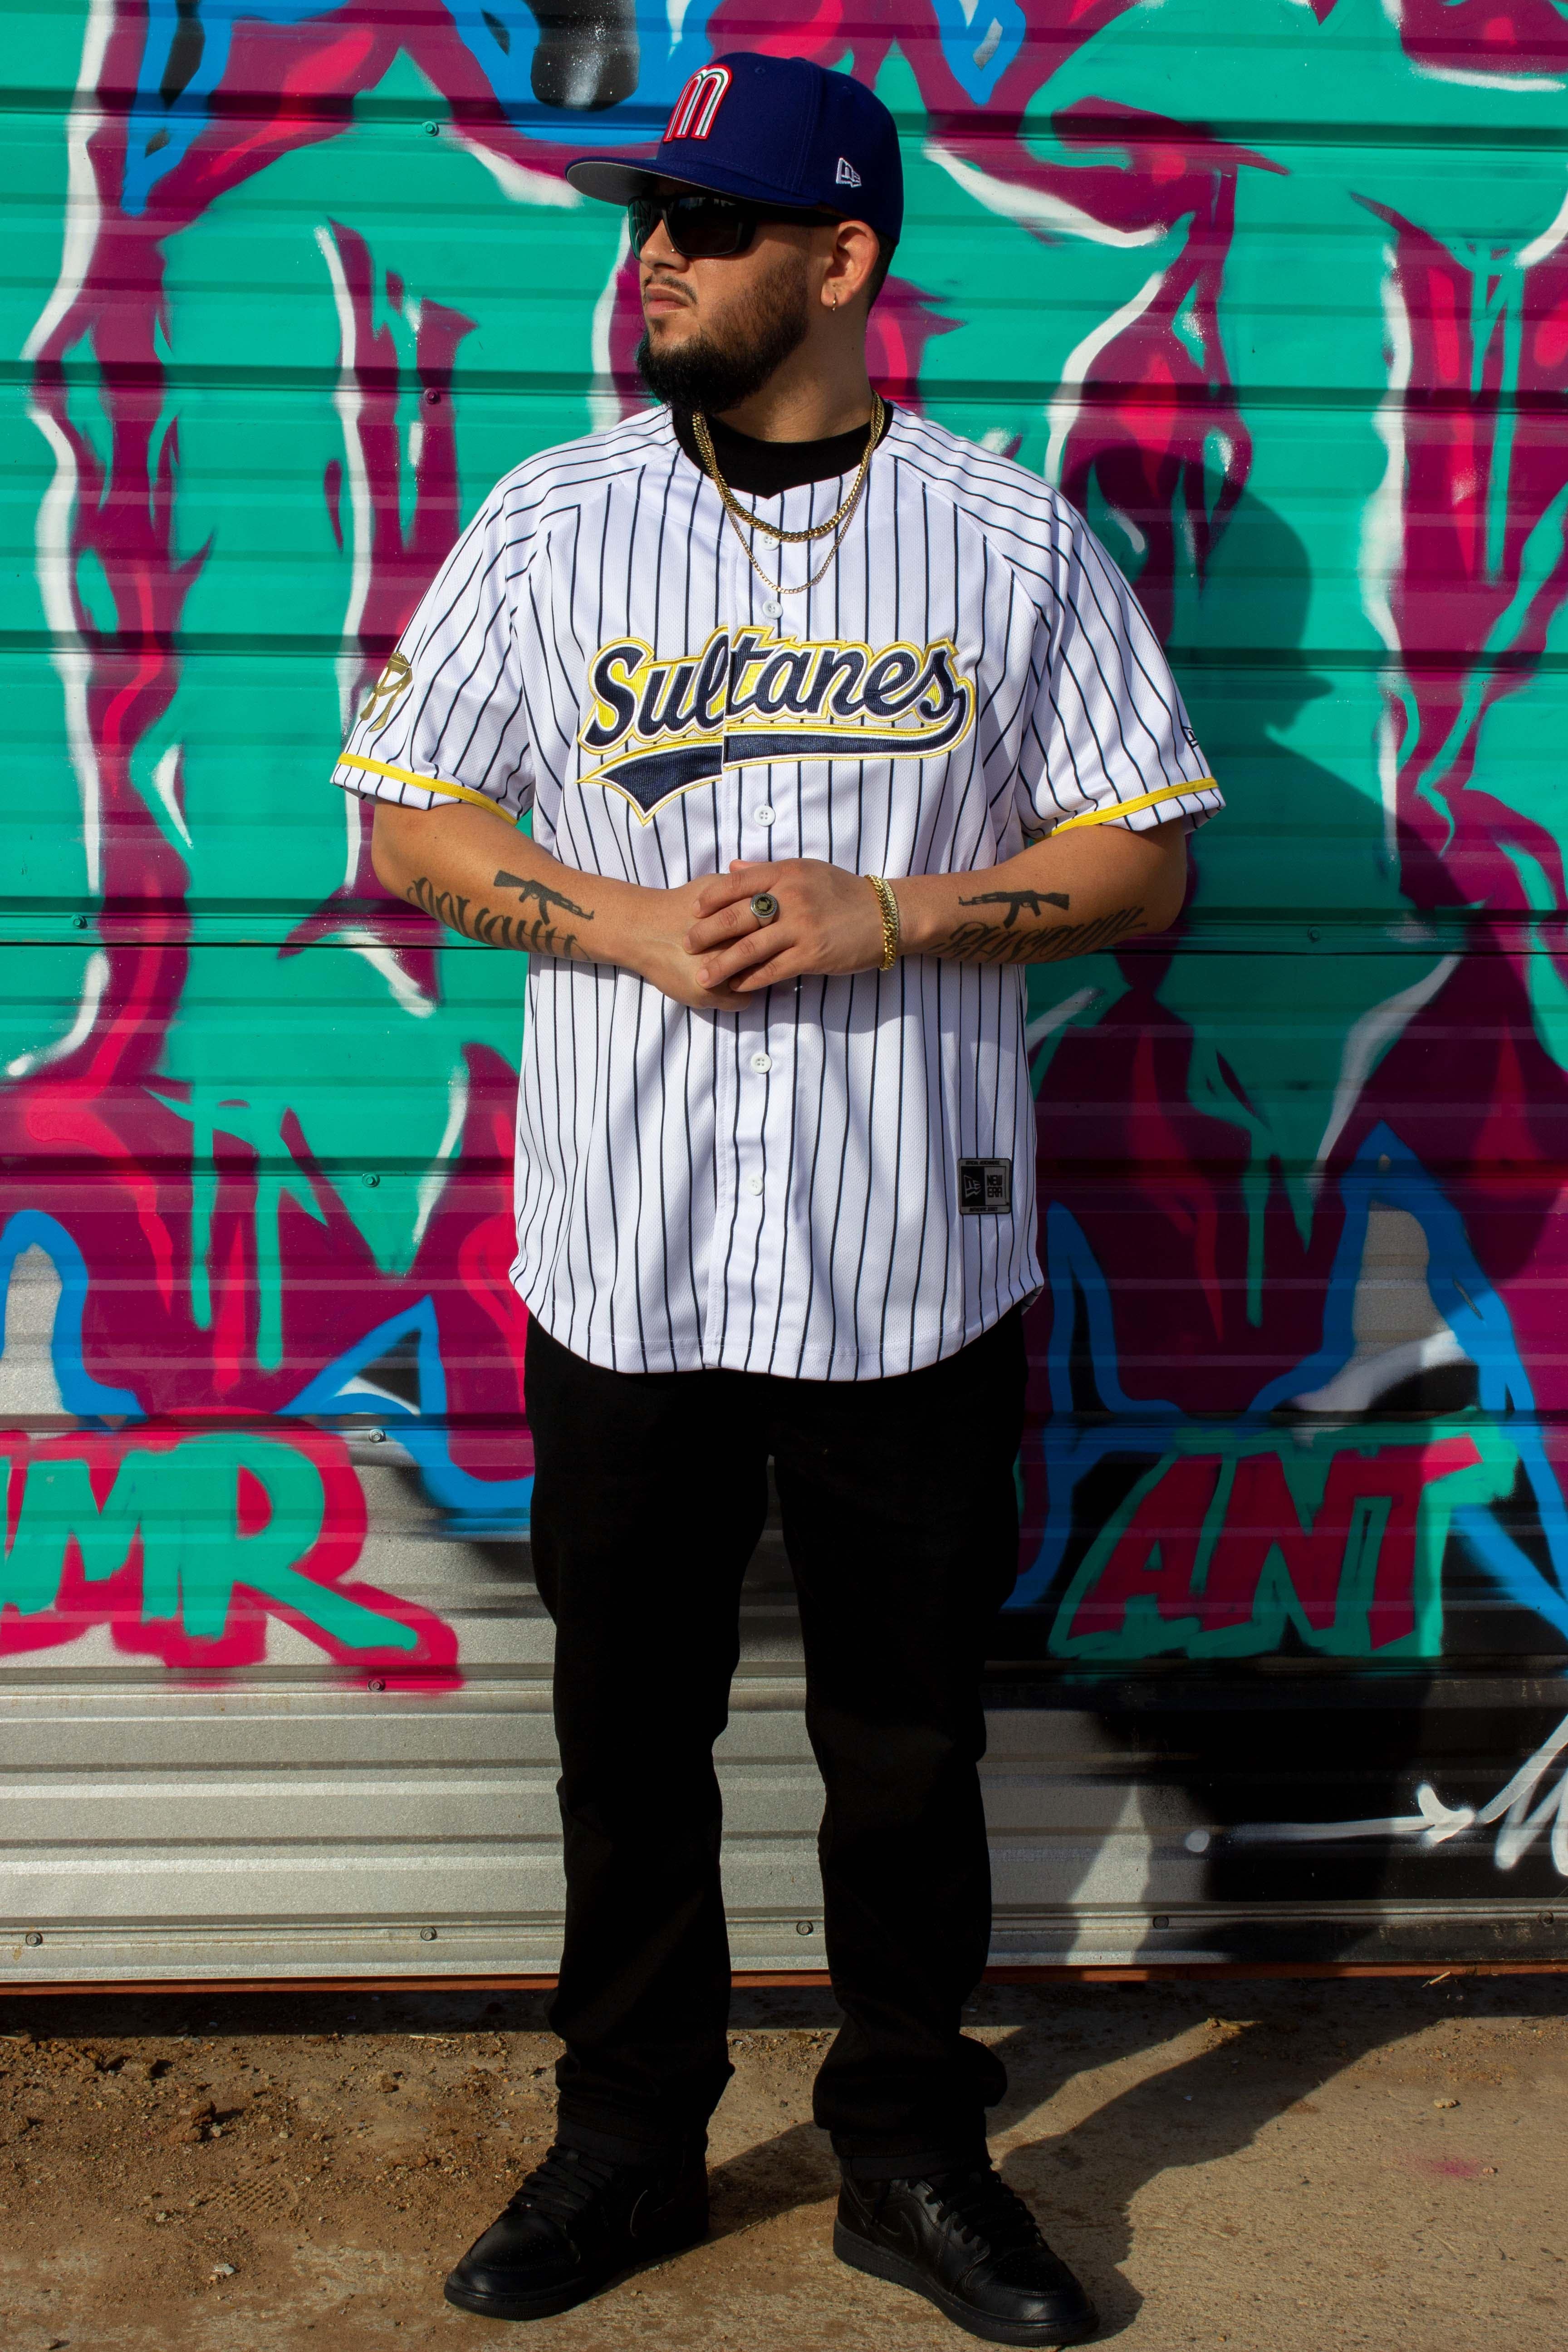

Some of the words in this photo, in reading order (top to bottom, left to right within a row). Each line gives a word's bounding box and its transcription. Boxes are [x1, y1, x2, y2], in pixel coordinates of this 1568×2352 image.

[577, 625, 976, 755] Sultanes
[986, 1175, 1003, 1186] NEW
[987, 1186, 1003, 1198] ERA
[1066, 1433, 1483, 1651] ANT
